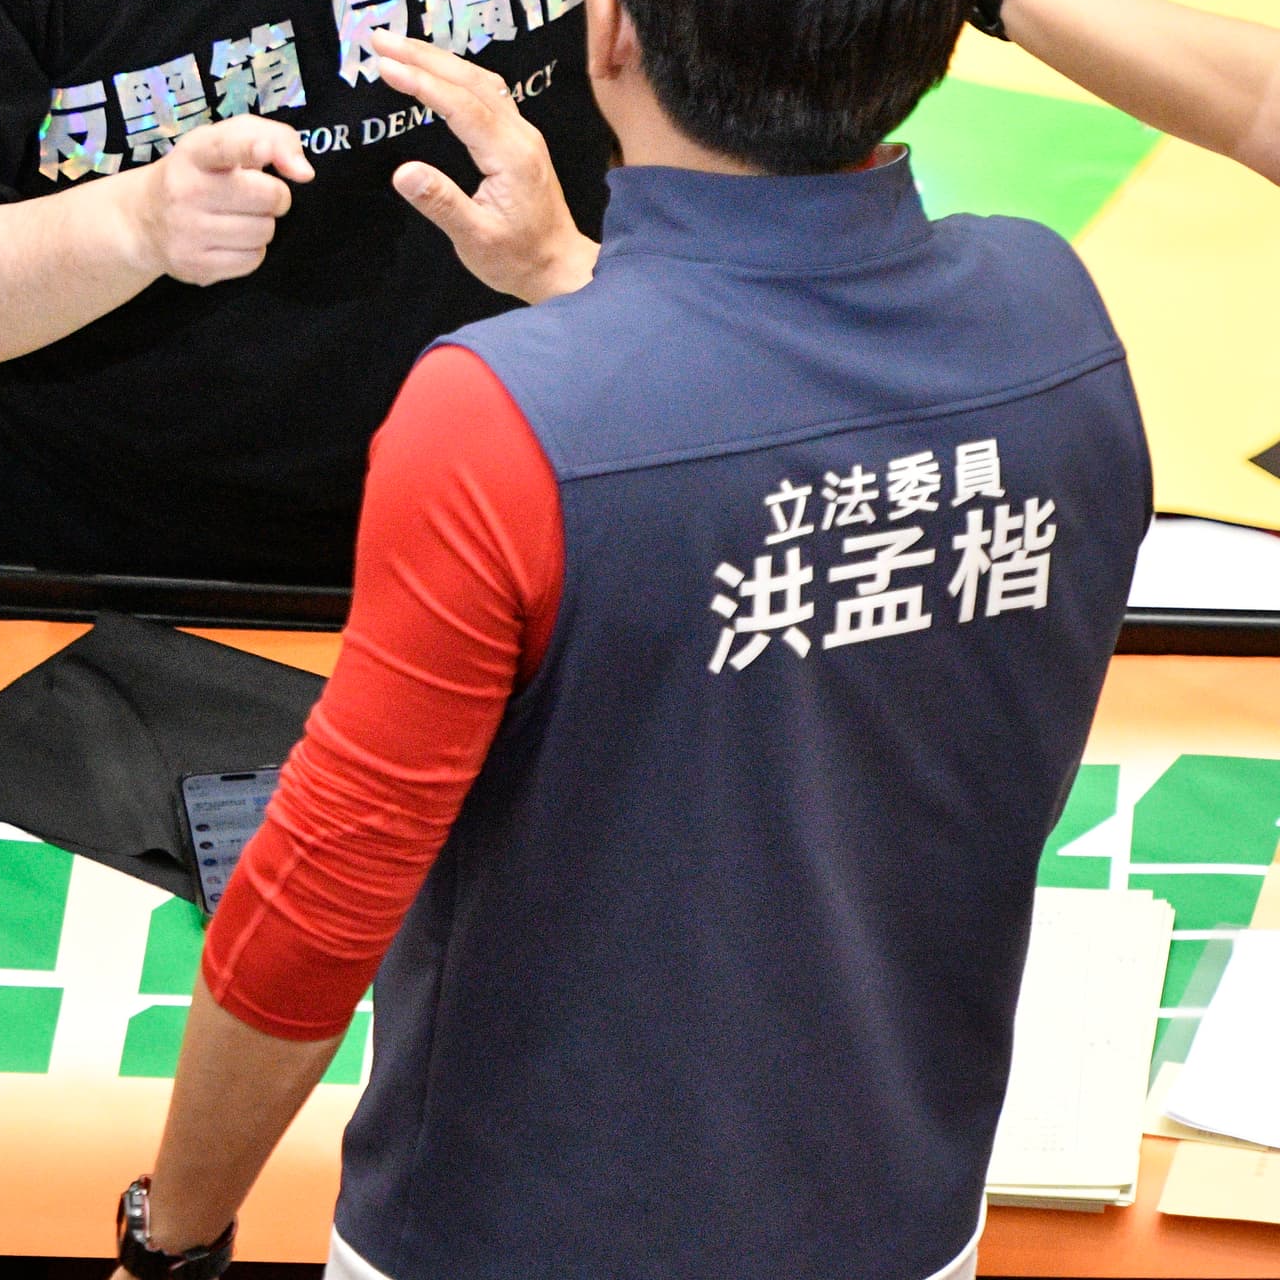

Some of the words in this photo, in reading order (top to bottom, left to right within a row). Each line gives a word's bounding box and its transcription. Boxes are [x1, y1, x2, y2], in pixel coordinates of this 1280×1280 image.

[764, 438, 1007, 546] 立法委員
[708, 498, 1059, 675] 洪孟楷
